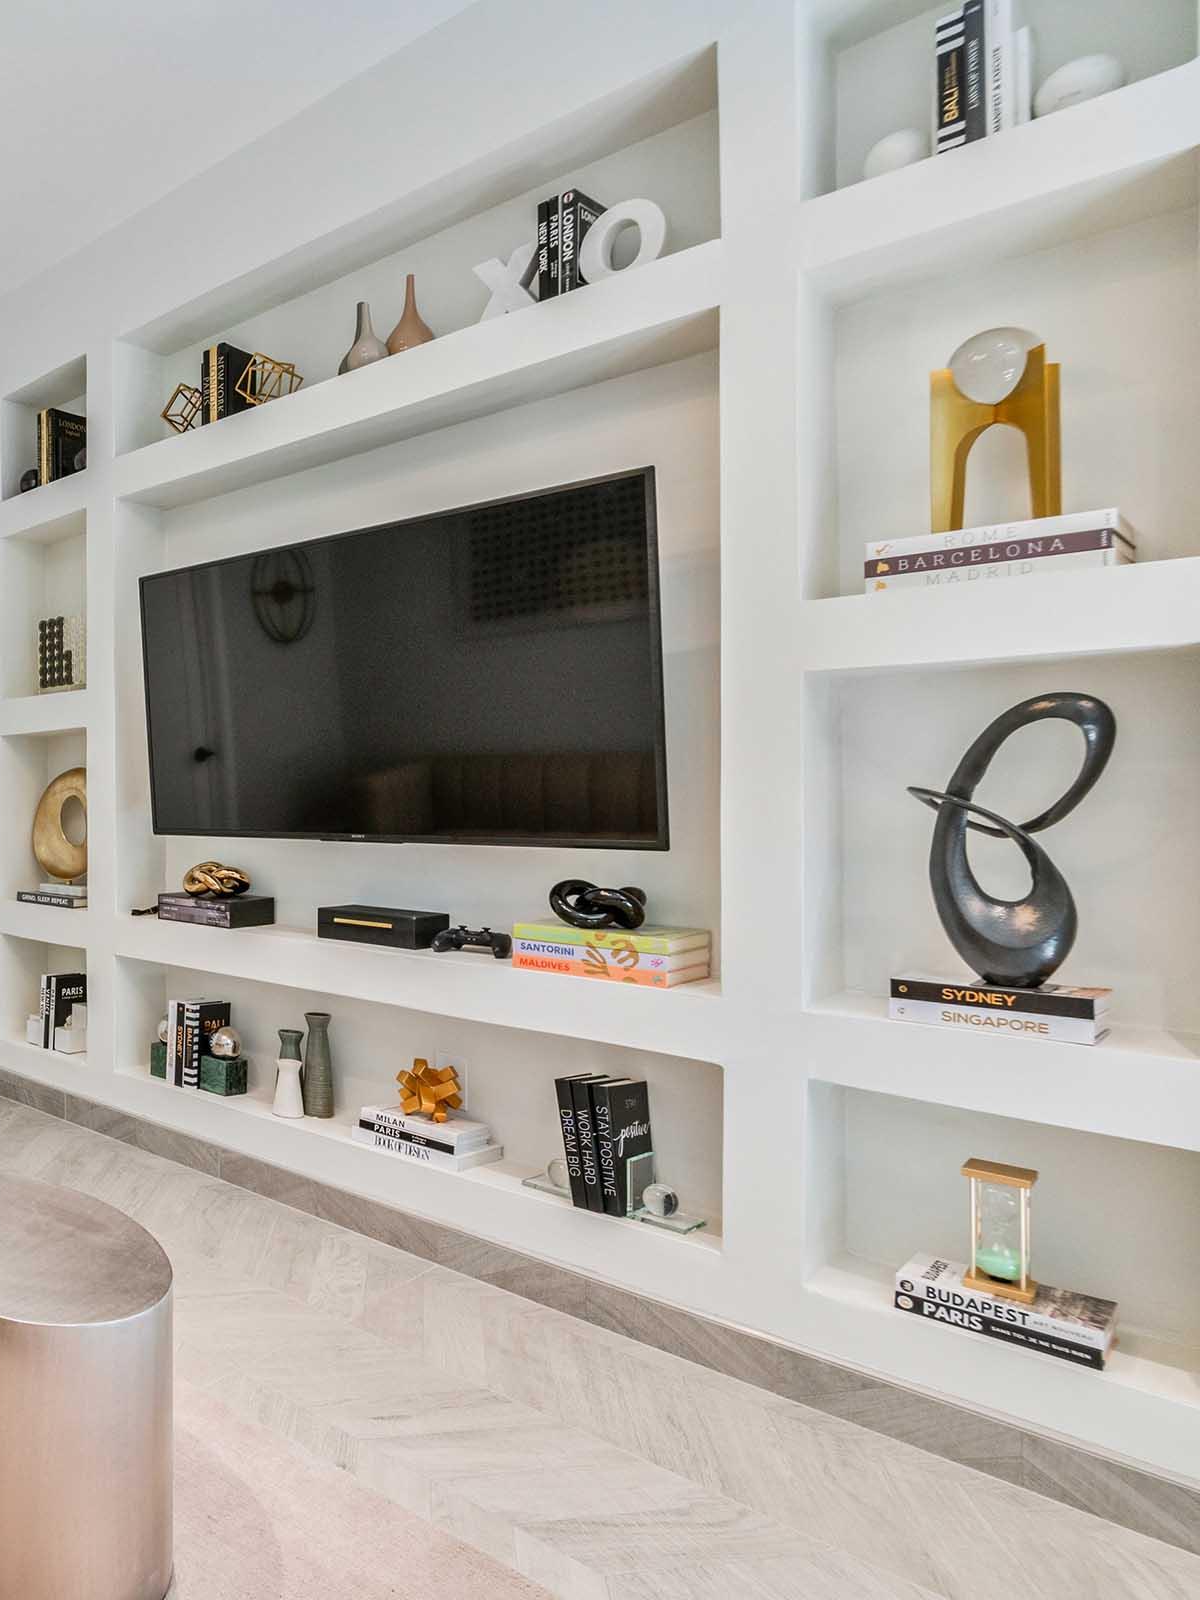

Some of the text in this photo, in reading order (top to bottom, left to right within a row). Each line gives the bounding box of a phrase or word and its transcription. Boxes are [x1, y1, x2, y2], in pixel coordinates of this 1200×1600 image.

[943, 86, 959, 123] BALI
[992, 91, 1001, 134] MANIFEST
[539, 222, 548, 273] NEW YORK
[550, 214, 559, 249] PARIS
[563, 208, 574, 262] LONDON
[579, 199, 666, 284] O
[944, 526, 1018, 547] ROME
[898, 538, 1065, 571] BARCELONA
[926, 562, 1034, 586] MADRID
[519, 958, 571, 971] MALDIVES
[520, 942, 575, 956] SANTORINI
[61, 986, 83, 997] PARIS
[942, 987, 1017, 1007] SYDNEY
[204, 1019, 224, 1035] BALI
[941, 1011, 1050, 1034] SINGAPORE
[176, 1025, 184, 1057] SYDNEY
[374, 1124, 401, 1138] PARIS
[375, 1113, 406, 1128] MILAN
[560, 1109, 581, 1177] DREAM BIG
[577, 1109, 597, 1185] WORK HARD
[596, 1106, 617, 1197] STAY POSITIVE
[922, 1301, 983, 1332] PARIS
[926, 1286, 1029, 1326] BUDAPEST
